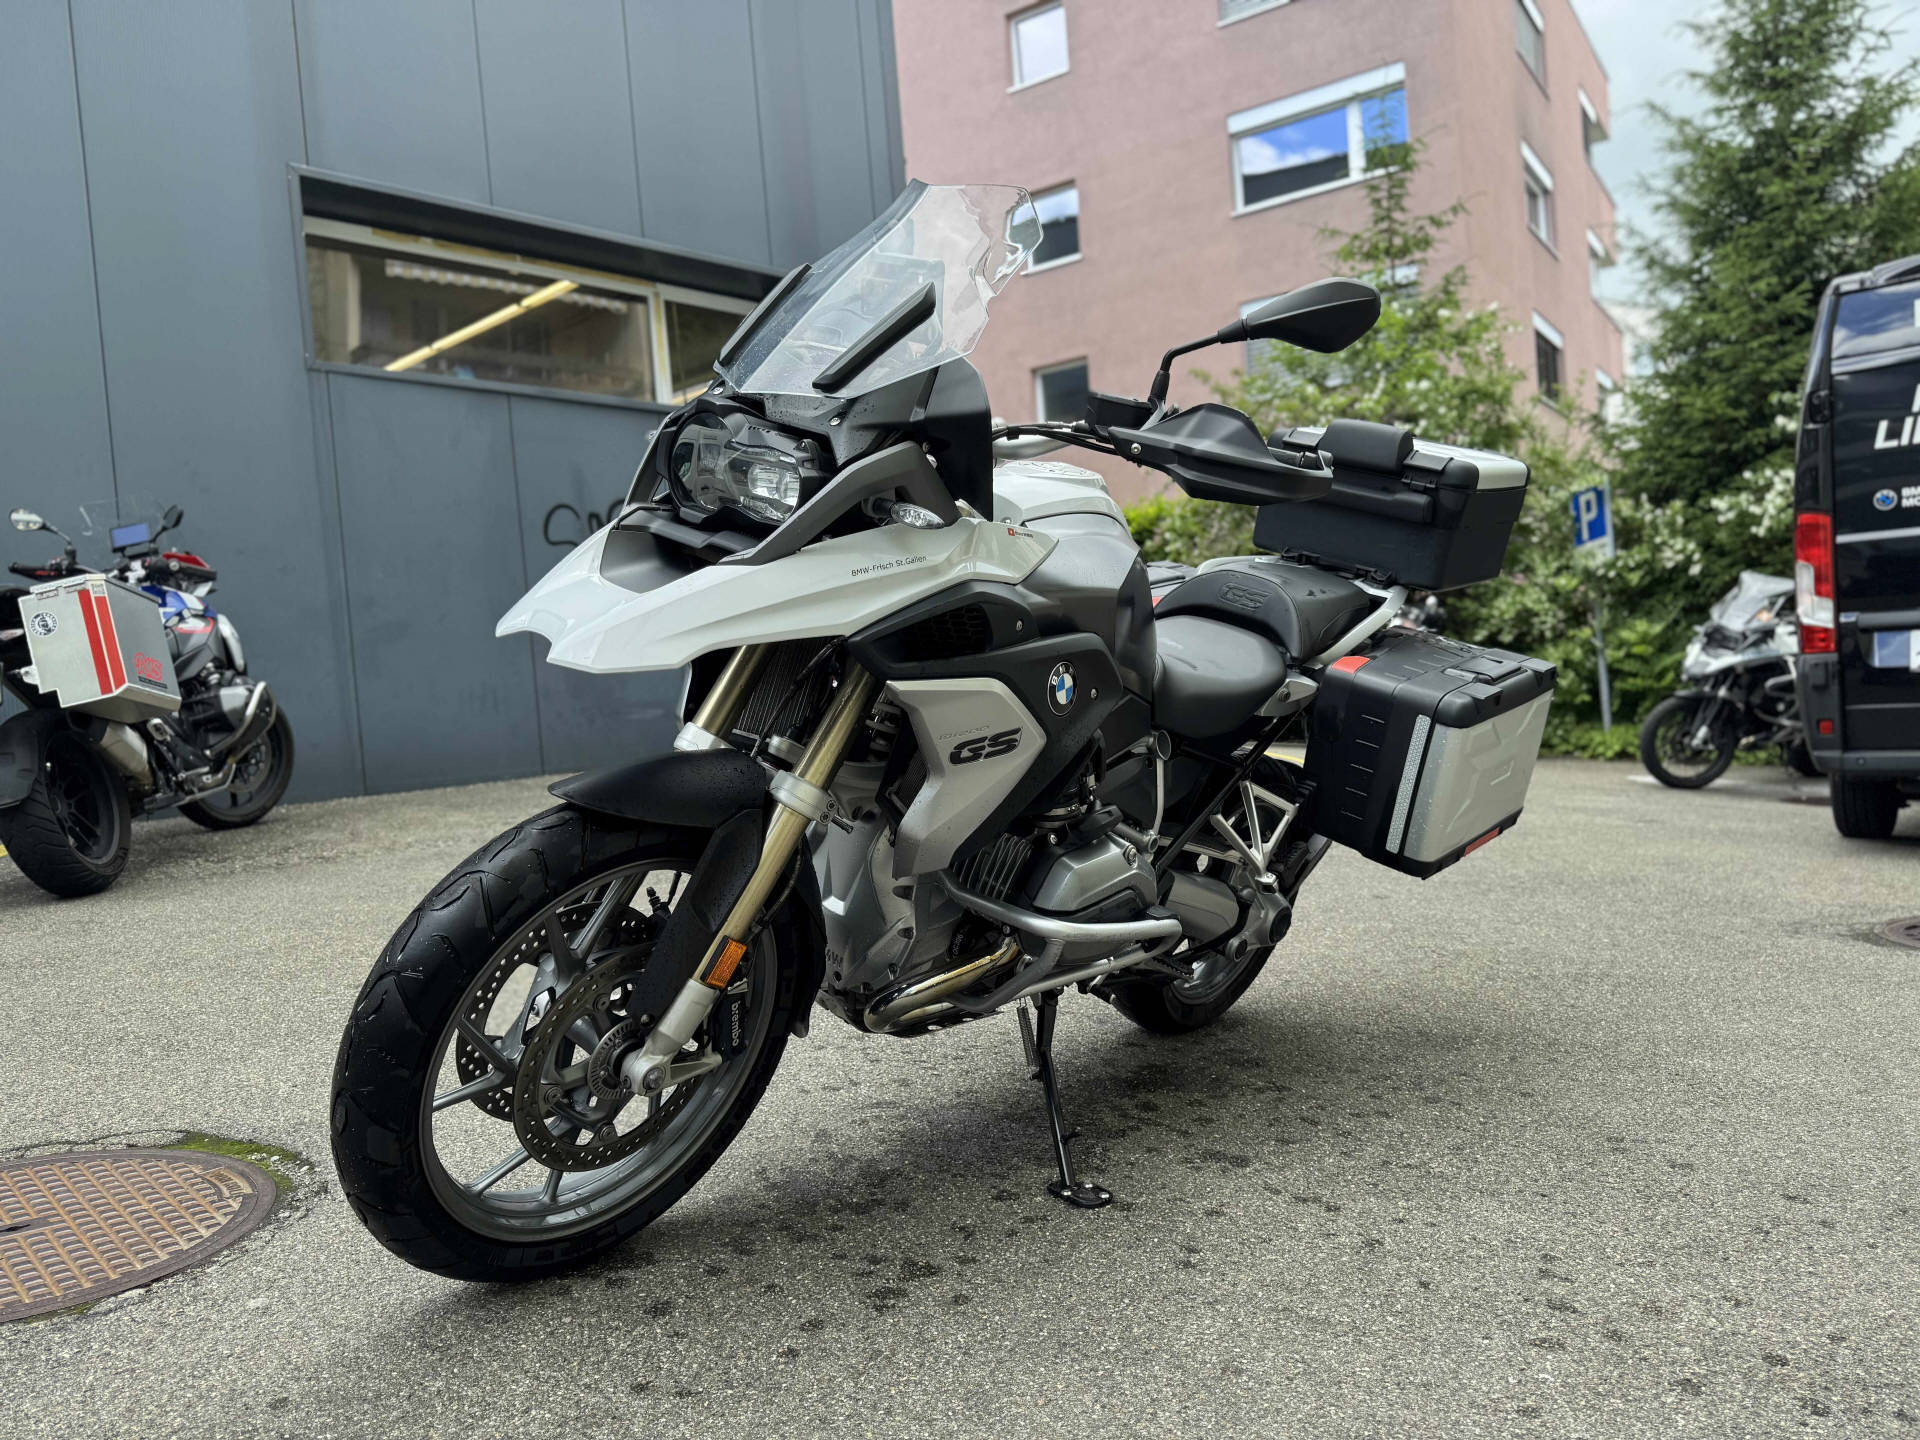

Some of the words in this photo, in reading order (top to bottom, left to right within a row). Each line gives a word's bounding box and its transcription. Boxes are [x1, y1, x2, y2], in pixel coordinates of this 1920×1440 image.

[1578, 491, 1598, 541] P
[851, 561, 894, 577] BMW-Frisch
[895, 555, 927, 567] St.Gallen
[1219, 582, 1273, 612] GS
[949, 727, 1024, 766] GS
[731, 1000, 742, 1047] brembo
